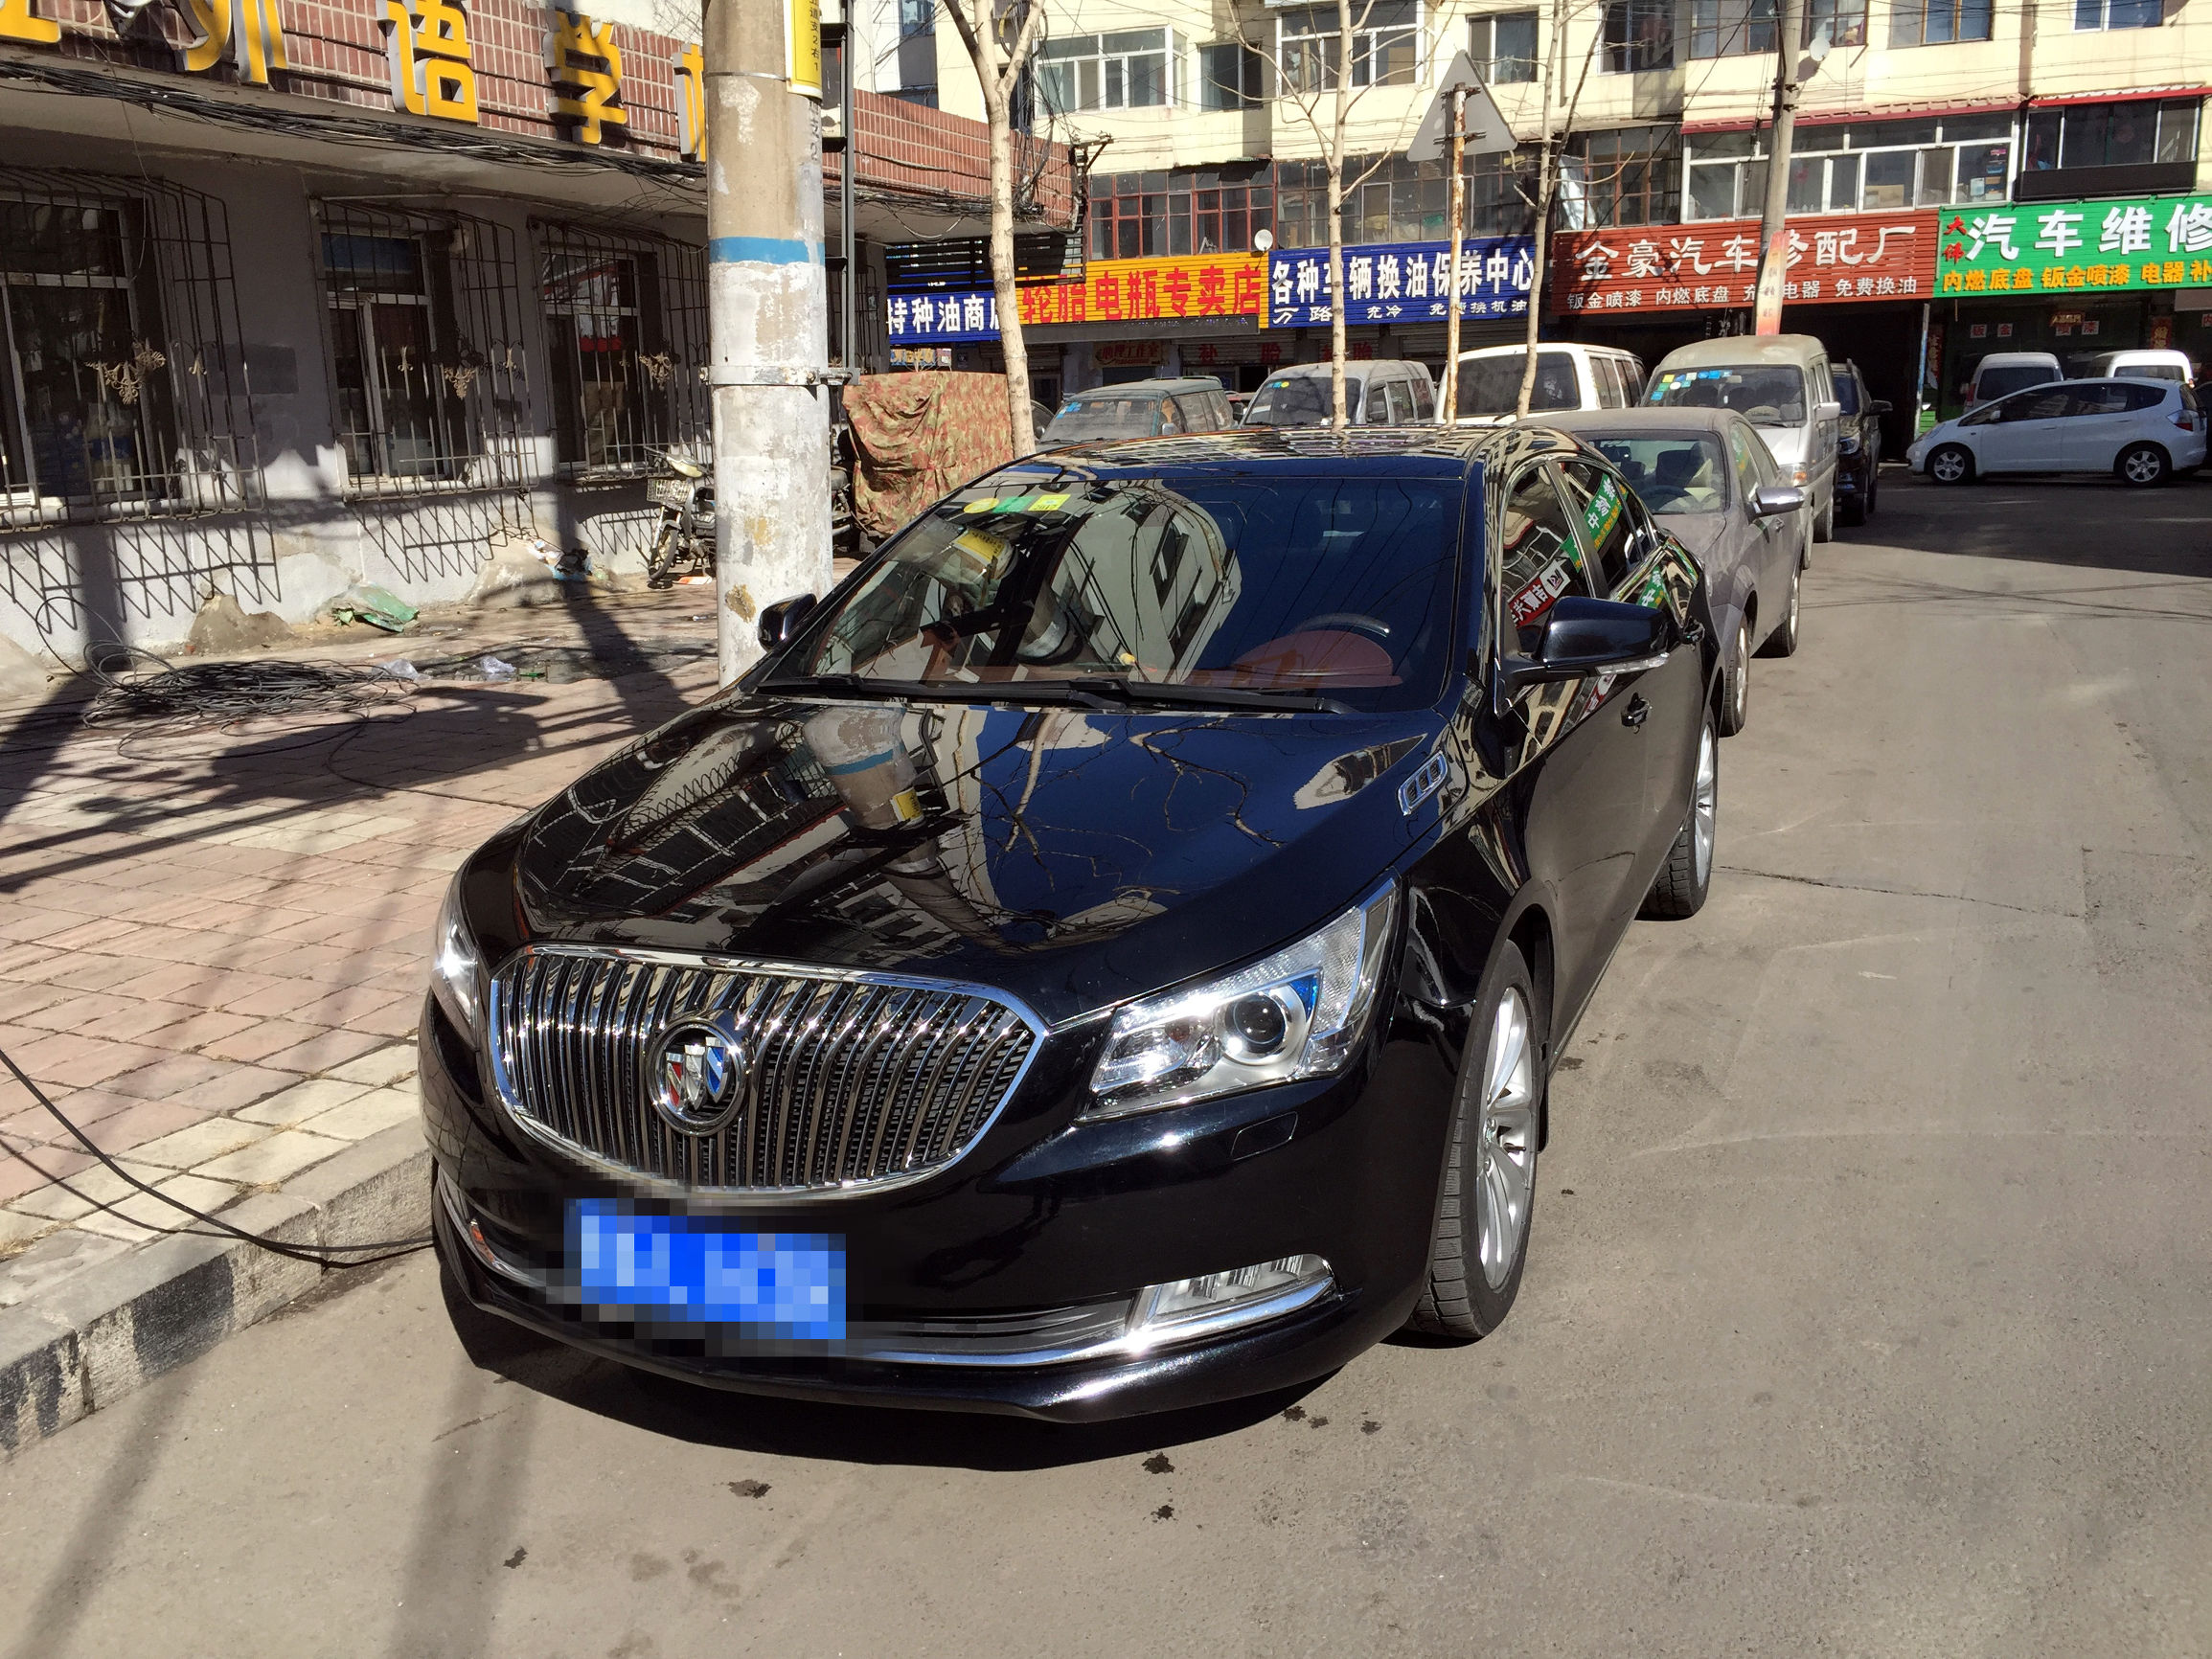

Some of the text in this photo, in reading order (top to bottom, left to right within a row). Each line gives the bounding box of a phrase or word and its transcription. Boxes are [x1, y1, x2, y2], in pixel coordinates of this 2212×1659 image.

[0, 0, 706, 163] 外语学
[1966, 203, 2212, 261] 汽车维修
[1021, 263, 1262, 326] 轮胎电瓶专卖店
[1566, 276, 1917, 310] 钣金喷漆 内燃底盘 充电器 免费换油
[1943, 267, 2034, 291] 内燃底盘
[2041, 262, 2131, 288] 钣金喷漆
[2141, 261, 2184, 284] 电器
[886, 293, 1000, 335] 特种油商
